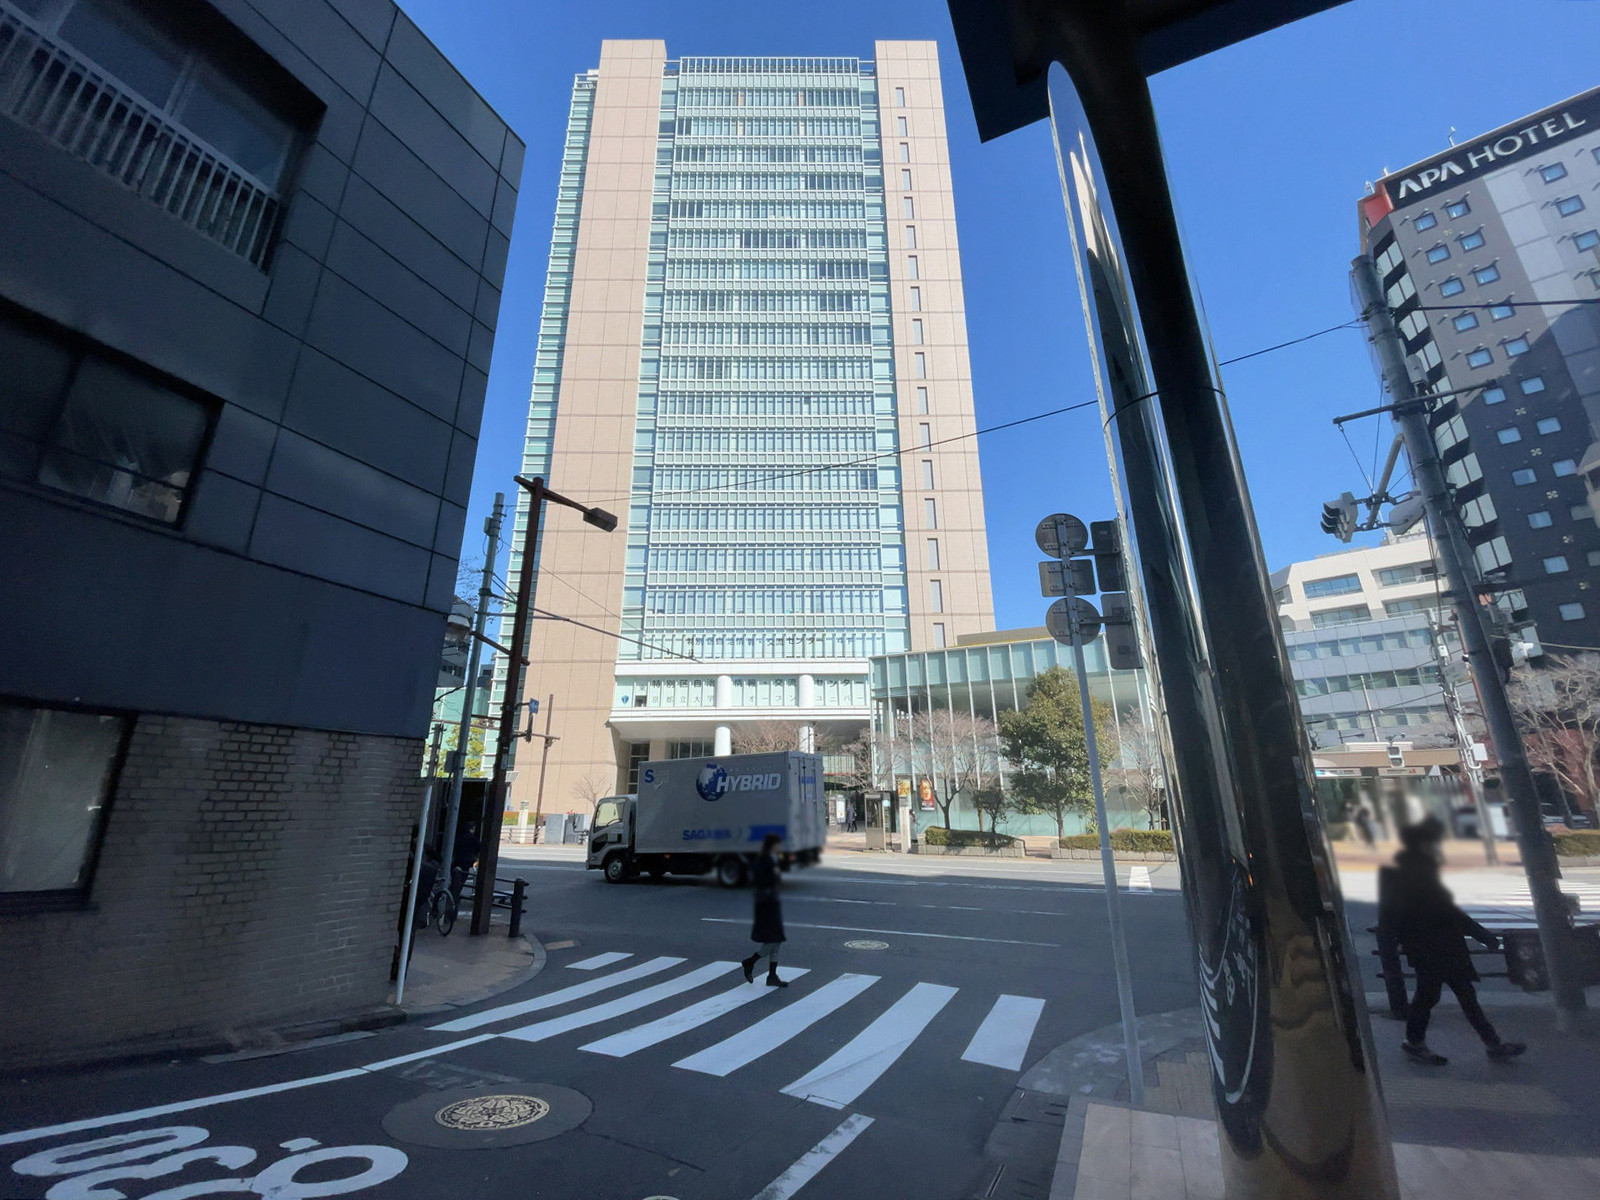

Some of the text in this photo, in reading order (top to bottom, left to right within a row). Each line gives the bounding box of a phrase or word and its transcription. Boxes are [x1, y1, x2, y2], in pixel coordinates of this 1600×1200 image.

[1398, 111, 1587, 200] APA HOTEL
[716, 772, 782, 793] HYBRID
